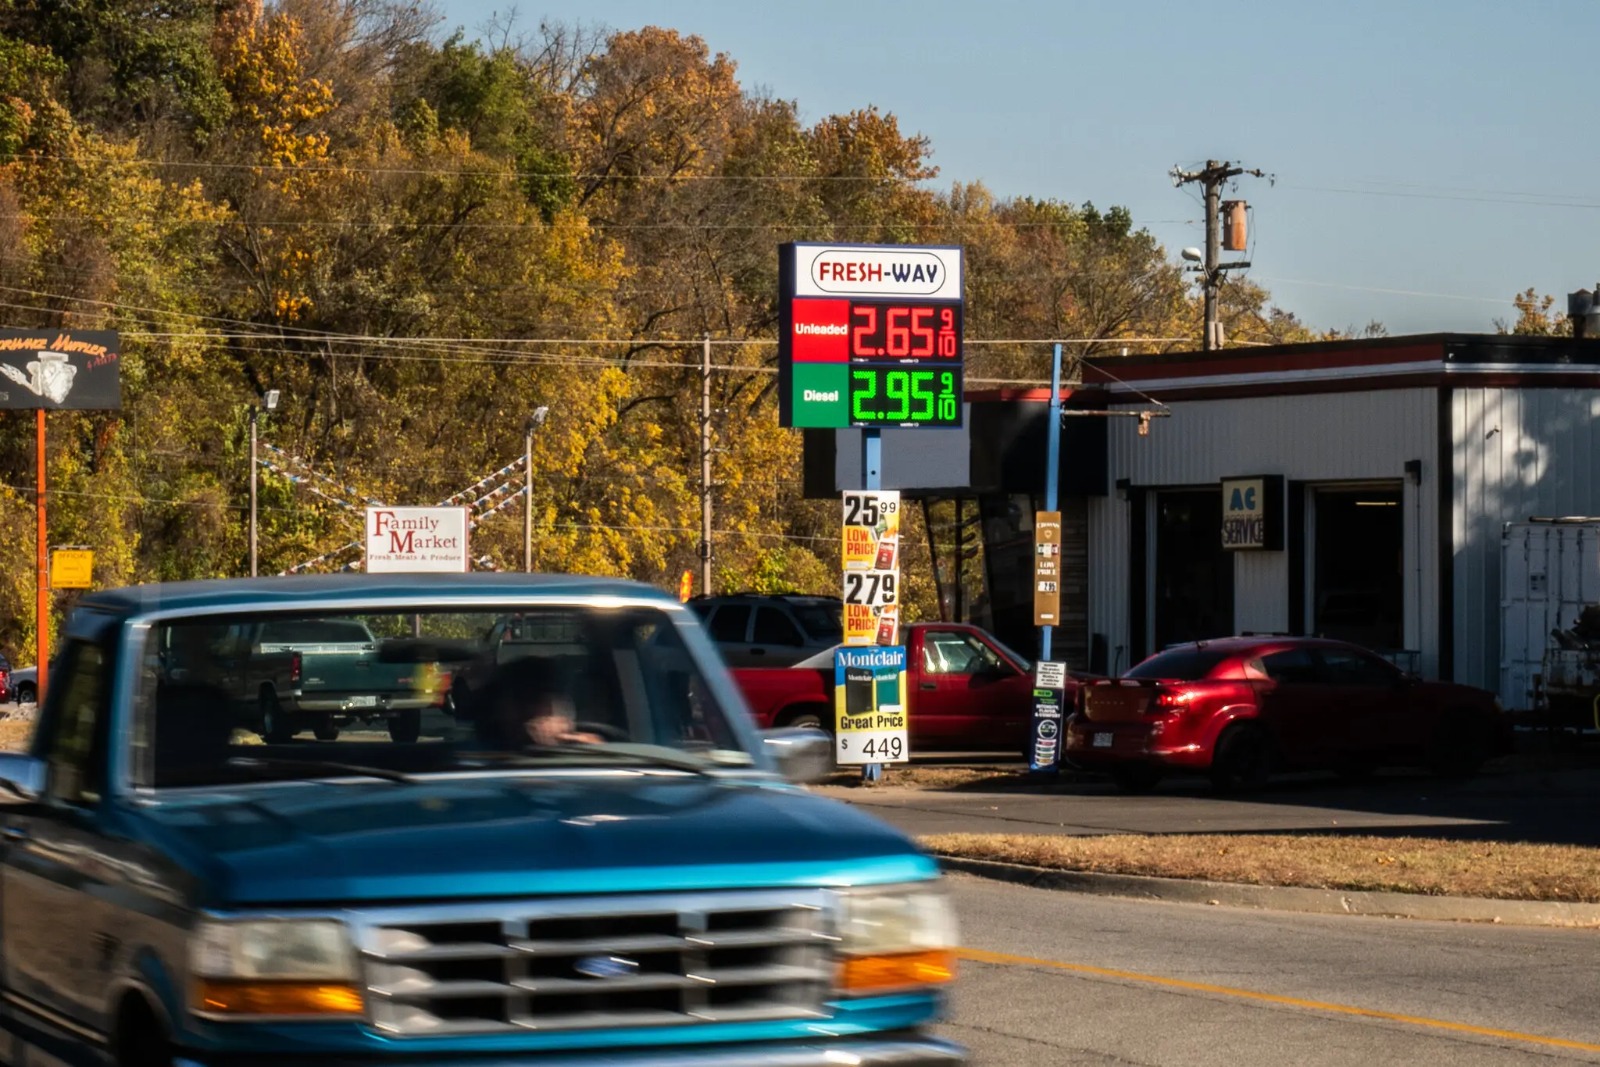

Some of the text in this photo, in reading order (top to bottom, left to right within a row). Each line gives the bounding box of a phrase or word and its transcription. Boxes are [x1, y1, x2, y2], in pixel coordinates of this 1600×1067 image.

[819, 262, 938, 283] FRESH-WAY
[795, 323, 848, 335] Unleaded
[853, 307, 934, 356] 2.65
[50, 333, 108, 358] MUFFLER
[803, 389, 839, 402] Diesel
[853, 371, 934, 420] 2.95
[1229, 486, 1256, 511] AC
[373, 511, 439, 536] Family
[847, 528, 869, 541] LOW
[1223, 518, 1263, 544] SERVICE
[389, 530, 458, 553] Market
[847, 542, 876, 555] PRICE
[848, 605, 870, 617] LOW
[848, 618, 876, 631] PRICE
[838, 651, 904, 667] Montclair
[841, 715, 903, 729] Great Price
